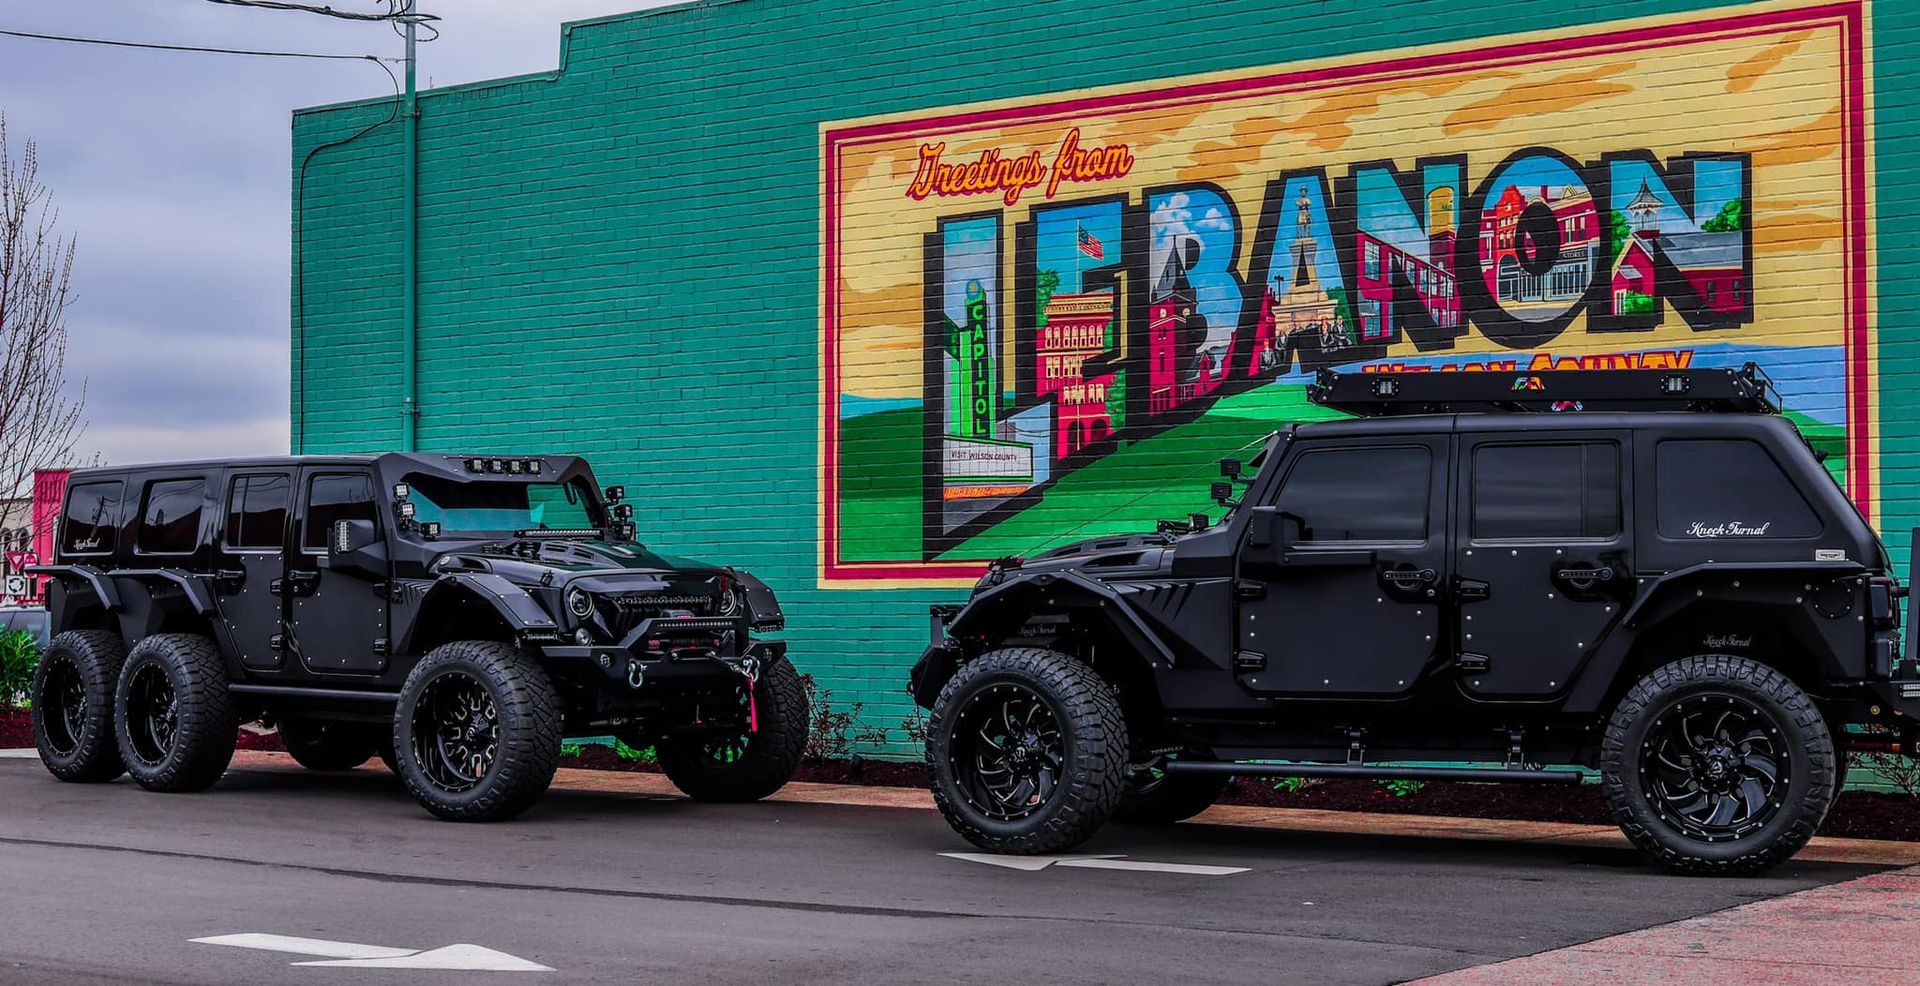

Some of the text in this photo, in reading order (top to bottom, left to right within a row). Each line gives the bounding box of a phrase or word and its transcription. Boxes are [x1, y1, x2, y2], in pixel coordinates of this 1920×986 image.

[906, 127, 1134, 206] Greetings from
[923, 146, 1753, 562] LEBANON
[972, 304, 987, 434] CAPITOL
[951, 451, 1017, 461] VISIT WILSON COUNTY
[1686, 521, 1770, 537] Knock Turnal
